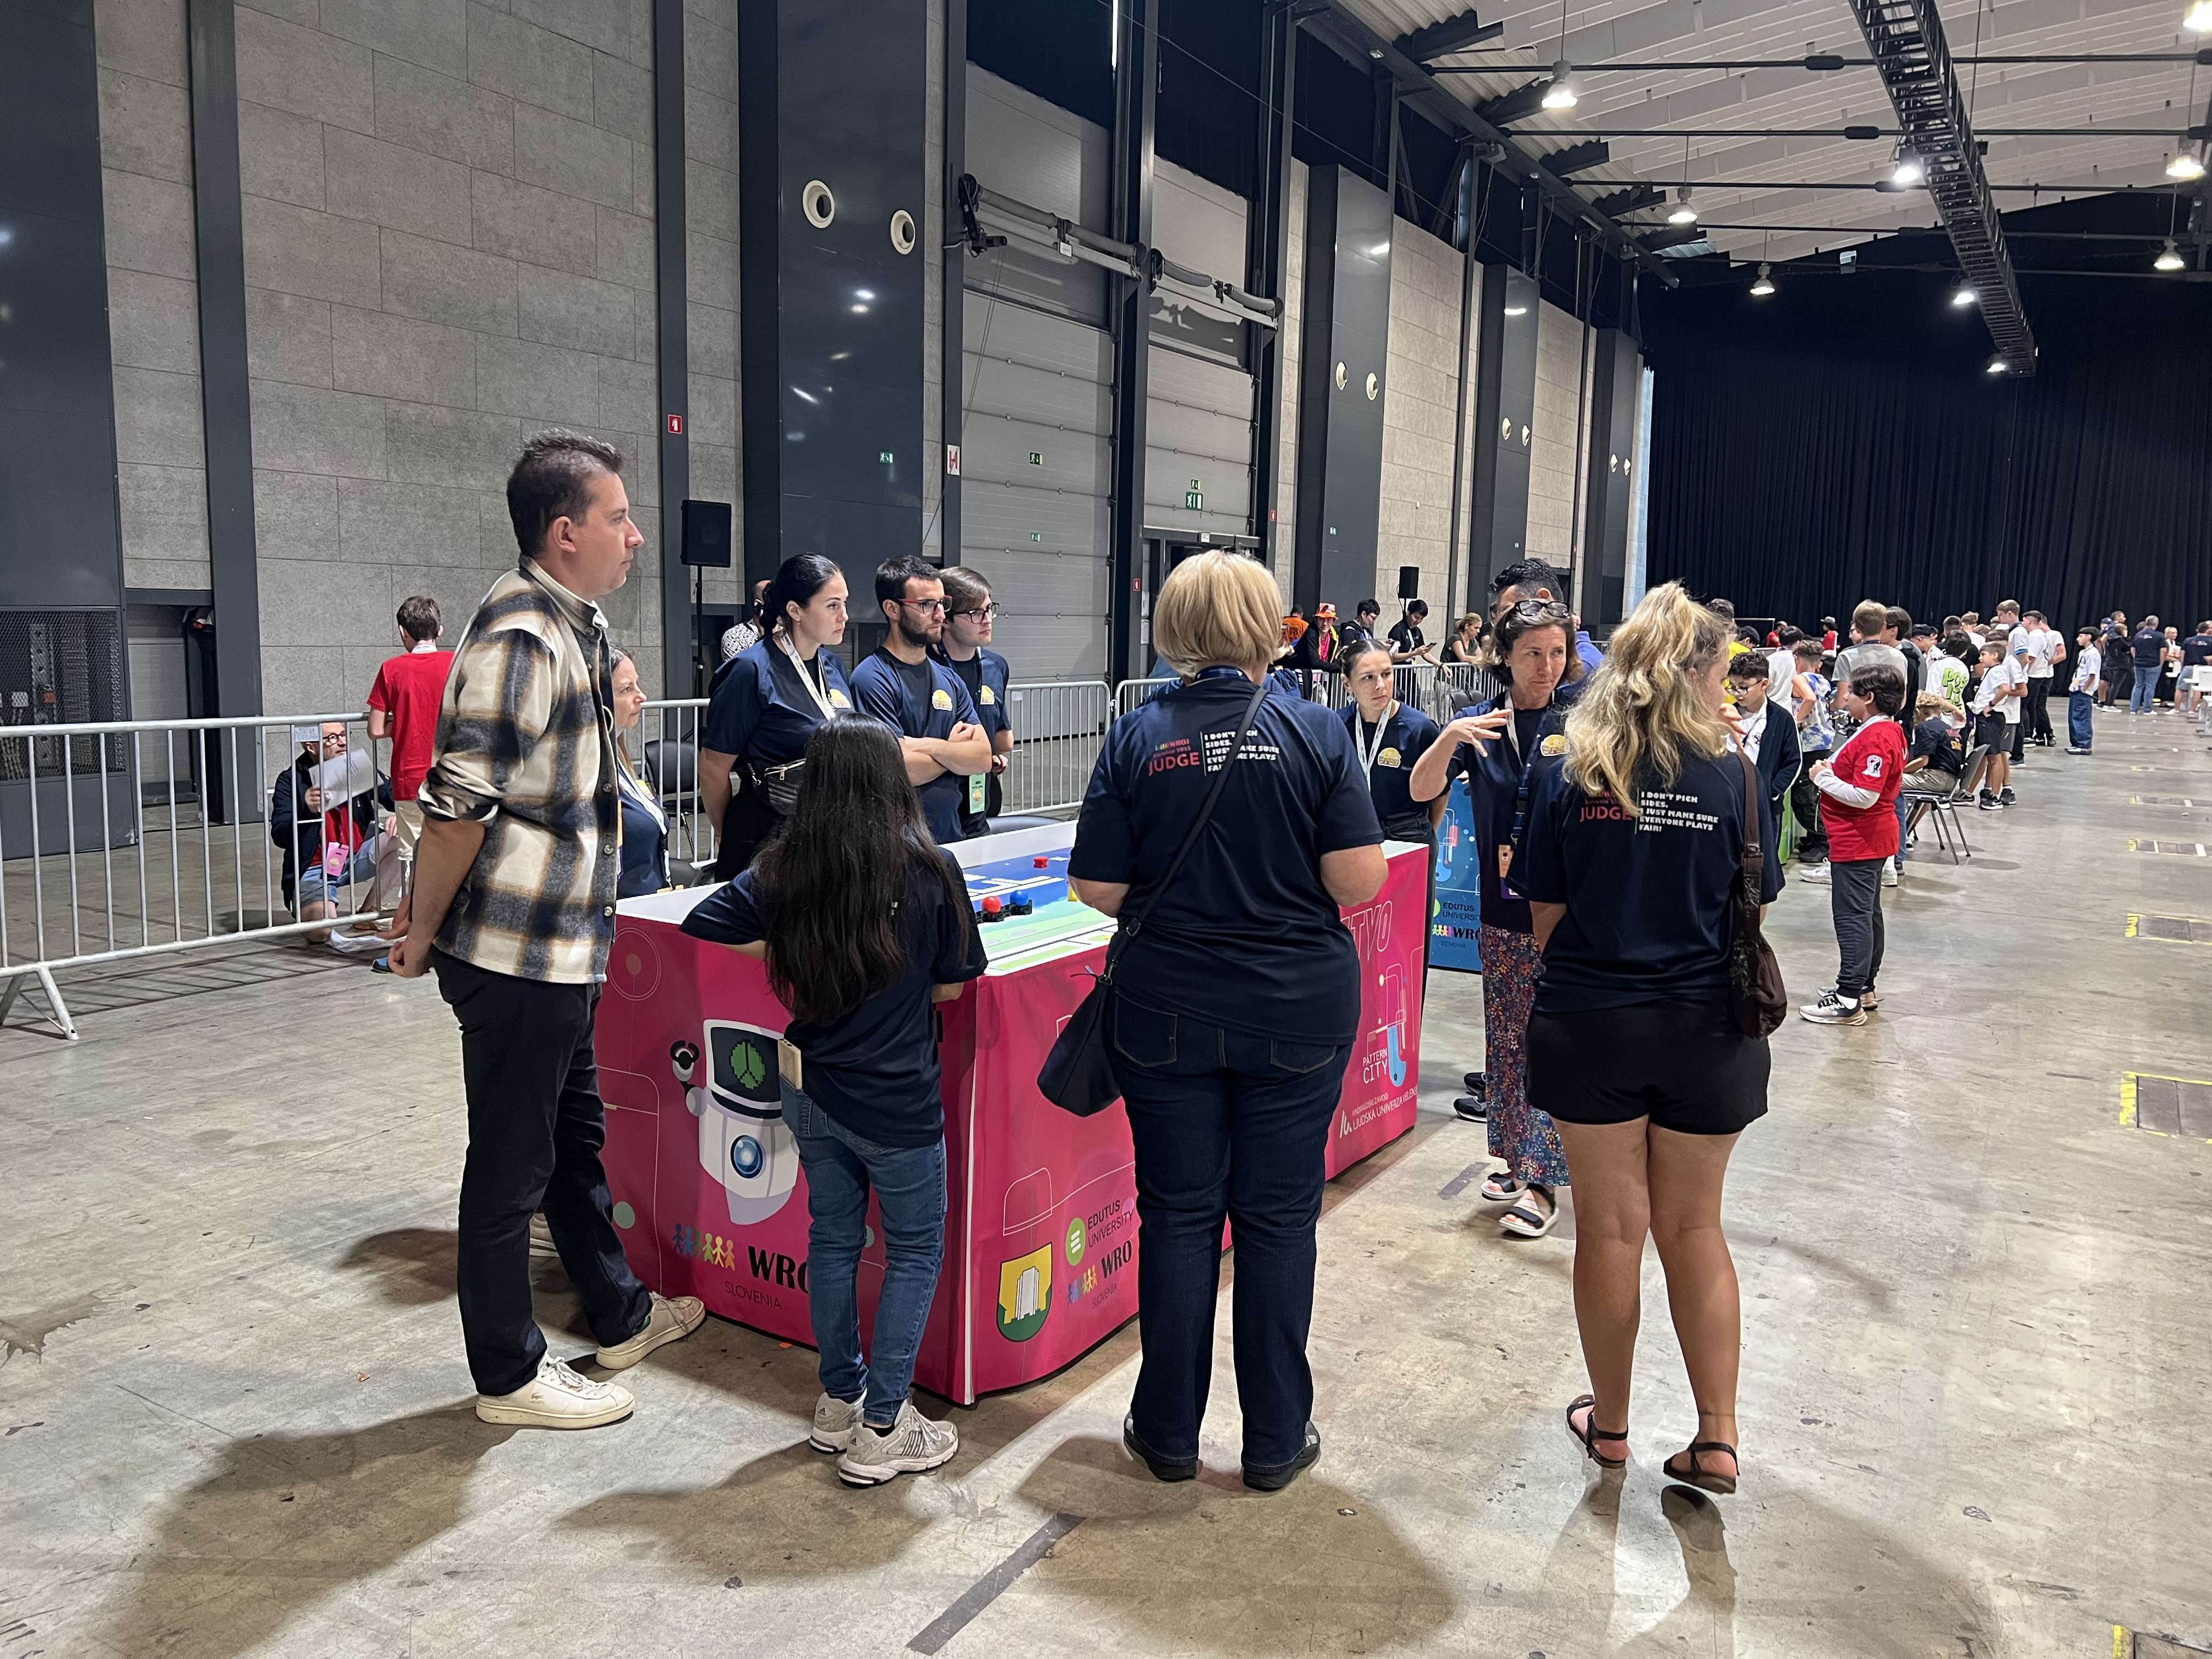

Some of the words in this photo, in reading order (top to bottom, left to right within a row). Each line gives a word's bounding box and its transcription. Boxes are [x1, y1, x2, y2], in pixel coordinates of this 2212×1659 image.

[1210, 731, 1236, 740] DON'T
[1258, 745, 1280, 754] SURE
[1149, 752, 1200, 777] JUDGE
[1640, 799, 1668, 808] SIDES.
[1646, 791, 1674, 800] DON'T
[1675, 794, 1699, 803] PICK
[1579, 806, 1633, 822] JUDGE
[1646, 808, 1666, 816] JUST
[1668, 810, 1695, 820] MAKE
[1696, 814, 1719, 823] SURE
[1639, 823, 1662, 832] FAIR!
[1640, 816, 1684, 827] EVERYONE
[1685, 820, 1713, 831] PLAYS
[1443, 902, 1475, 912] EDUTUS
[1442, 911, 1480, 921] UNIVERSI
[1363, 1047, 1387, 1068] PATTERN
[1363, 1058, 1388, 1084] CITY
[1353, 1109, 1376, 1130] LJUDSKA
[1376, 1096, 1402, 1117] UNIVERZA
[1088, 1200, 1120, 1230] EDUTUS
[1088, 1209, 1135, 1248] UNIVERSITY
[1101, 1239, 1132, 1279] WRO
[724, 1281, 782, 1311] SLOVENIA
